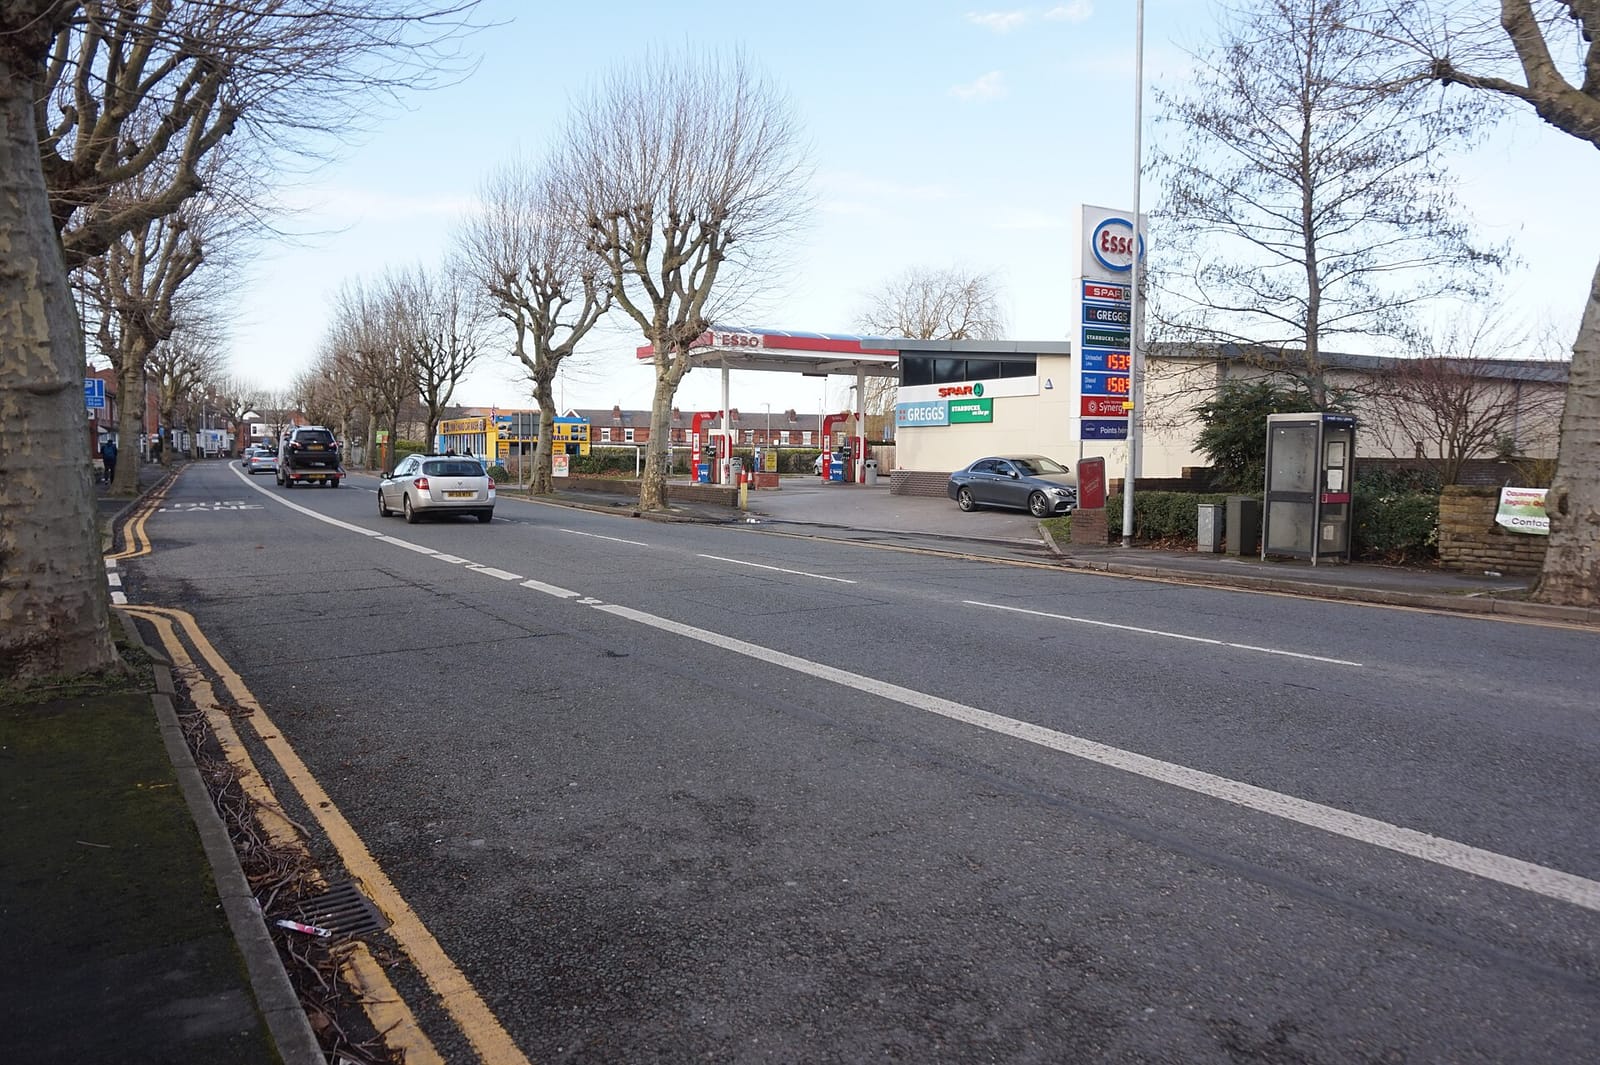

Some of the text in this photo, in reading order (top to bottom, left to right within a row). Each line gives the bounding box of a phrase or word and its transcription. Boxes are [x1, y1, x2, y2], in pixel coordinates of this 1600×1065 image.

[1096, 310, 1128, 321] GREGGS
[722, 335, 759, 347] ESSO
[1086, 334, 1114, 342] STARBUCKS
[938, 386, 973, 397] SPAR
[907, 406, 945, 421] GREGGS
[1100, 426, 1117, 434] Points
[1511, 517, 1549, 527] Contac
